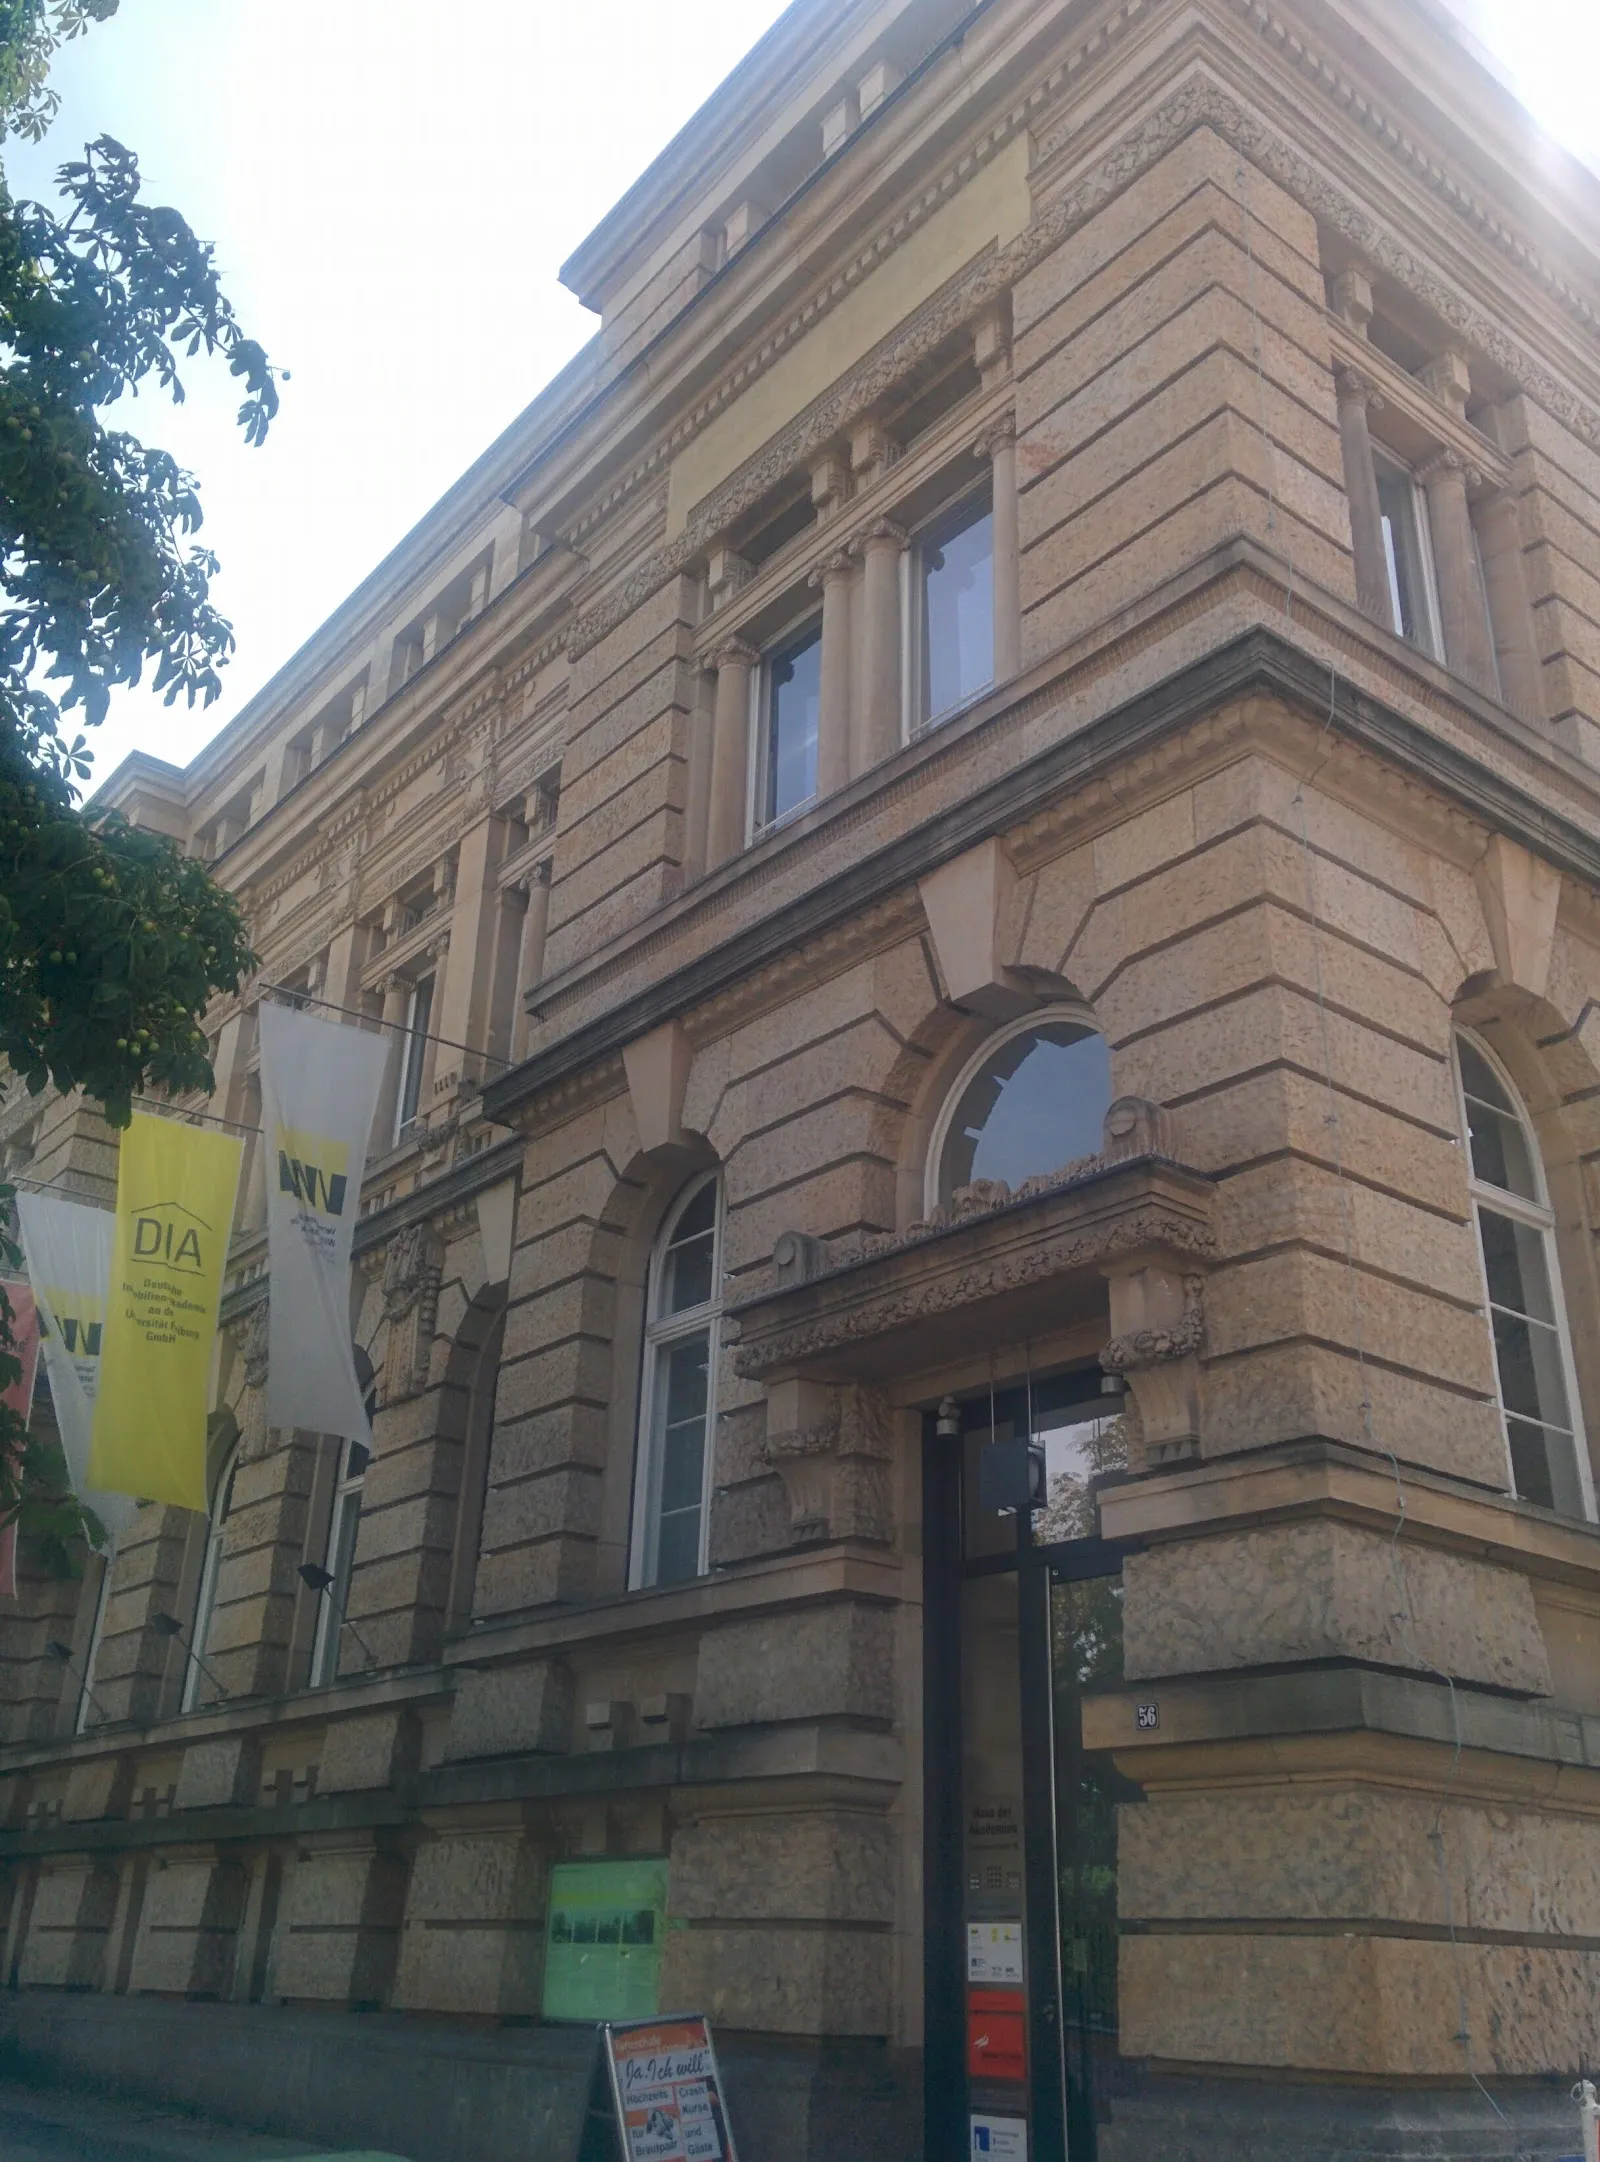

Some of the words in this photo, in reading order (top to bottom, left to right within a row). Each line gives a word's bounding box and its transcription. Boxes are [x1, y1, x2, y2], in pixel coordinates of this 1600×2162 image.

[134, 1217, 202, 1268] DIA
[147, 1306, 161, 1315] an
[164, 1307, 174, 1317] de
[145, 1331, 176, 1344] GmbH
[1138, 1706, 1156, 1727] 56
[626, 2089, 669, 2105] Hochzeits
[679, 2085, 705, 2099] Crash
[682, 2103, 709, 2115] Kurse
[685, 2125, 702, 2138] und
[635, 2140, 678, 2157] Brautpaar
[687, 2142, 713, 2155] Gäste
